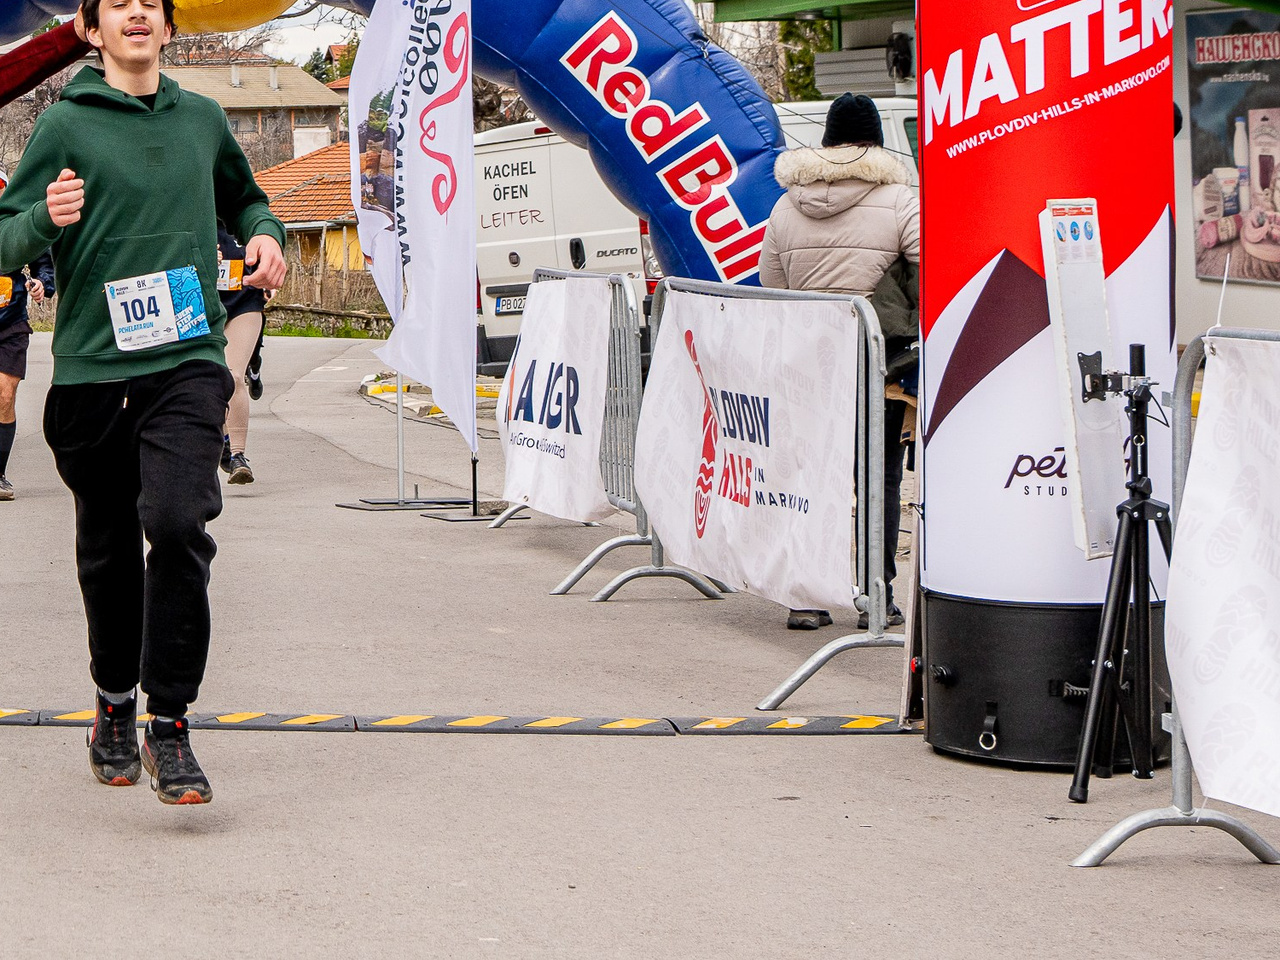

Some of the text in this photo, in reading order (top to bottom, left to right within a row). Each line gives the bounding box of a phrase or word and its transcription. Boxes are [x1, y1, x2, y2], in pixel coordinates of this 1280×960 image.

[946, 54, 1171, 159] WWW.PLOVDIV-HILLS-IN-MARKOVO.COM
[564, 15, 768, 281] Red Bull
[483, 160, 537, 180] KACHEL
[492, 183, 529, 201] ÖFEN
[480, 208, 545, 230] LEITER
[596, 246, 638, 258] DUCATO
[120, 295, 160, 323] 104
[754, 466, 765, 483] IN
